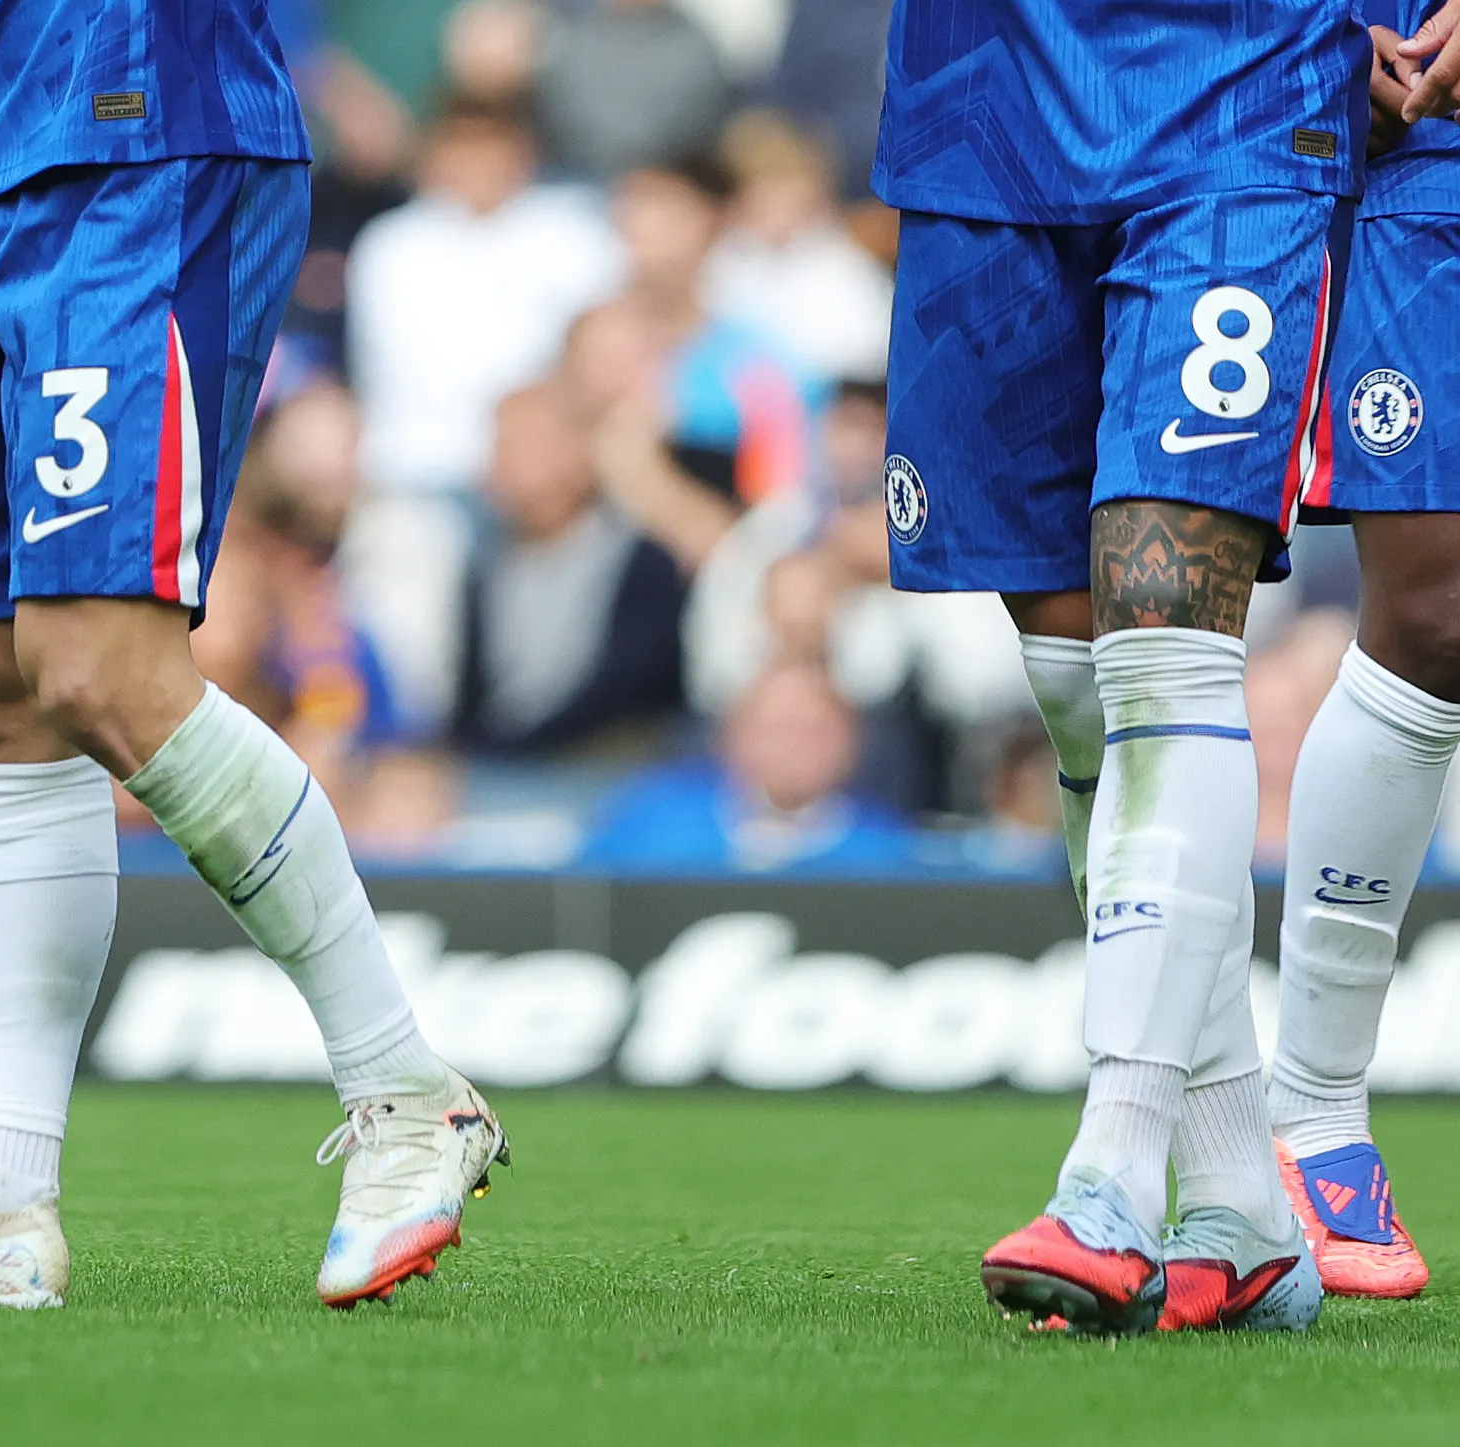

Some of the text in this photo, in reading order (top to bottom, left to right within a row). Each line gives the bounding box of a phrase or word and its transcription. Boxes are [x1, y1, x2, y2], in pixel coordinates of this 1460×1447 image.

[1181, 285, 1273, 419] 8
[1360, 373, 1407, 391] CHELSEA
[35, 367, 110, 498] 3
[1320, 867, 1390, 894] CFC
[1094, 901, 1164, 920] CFC
